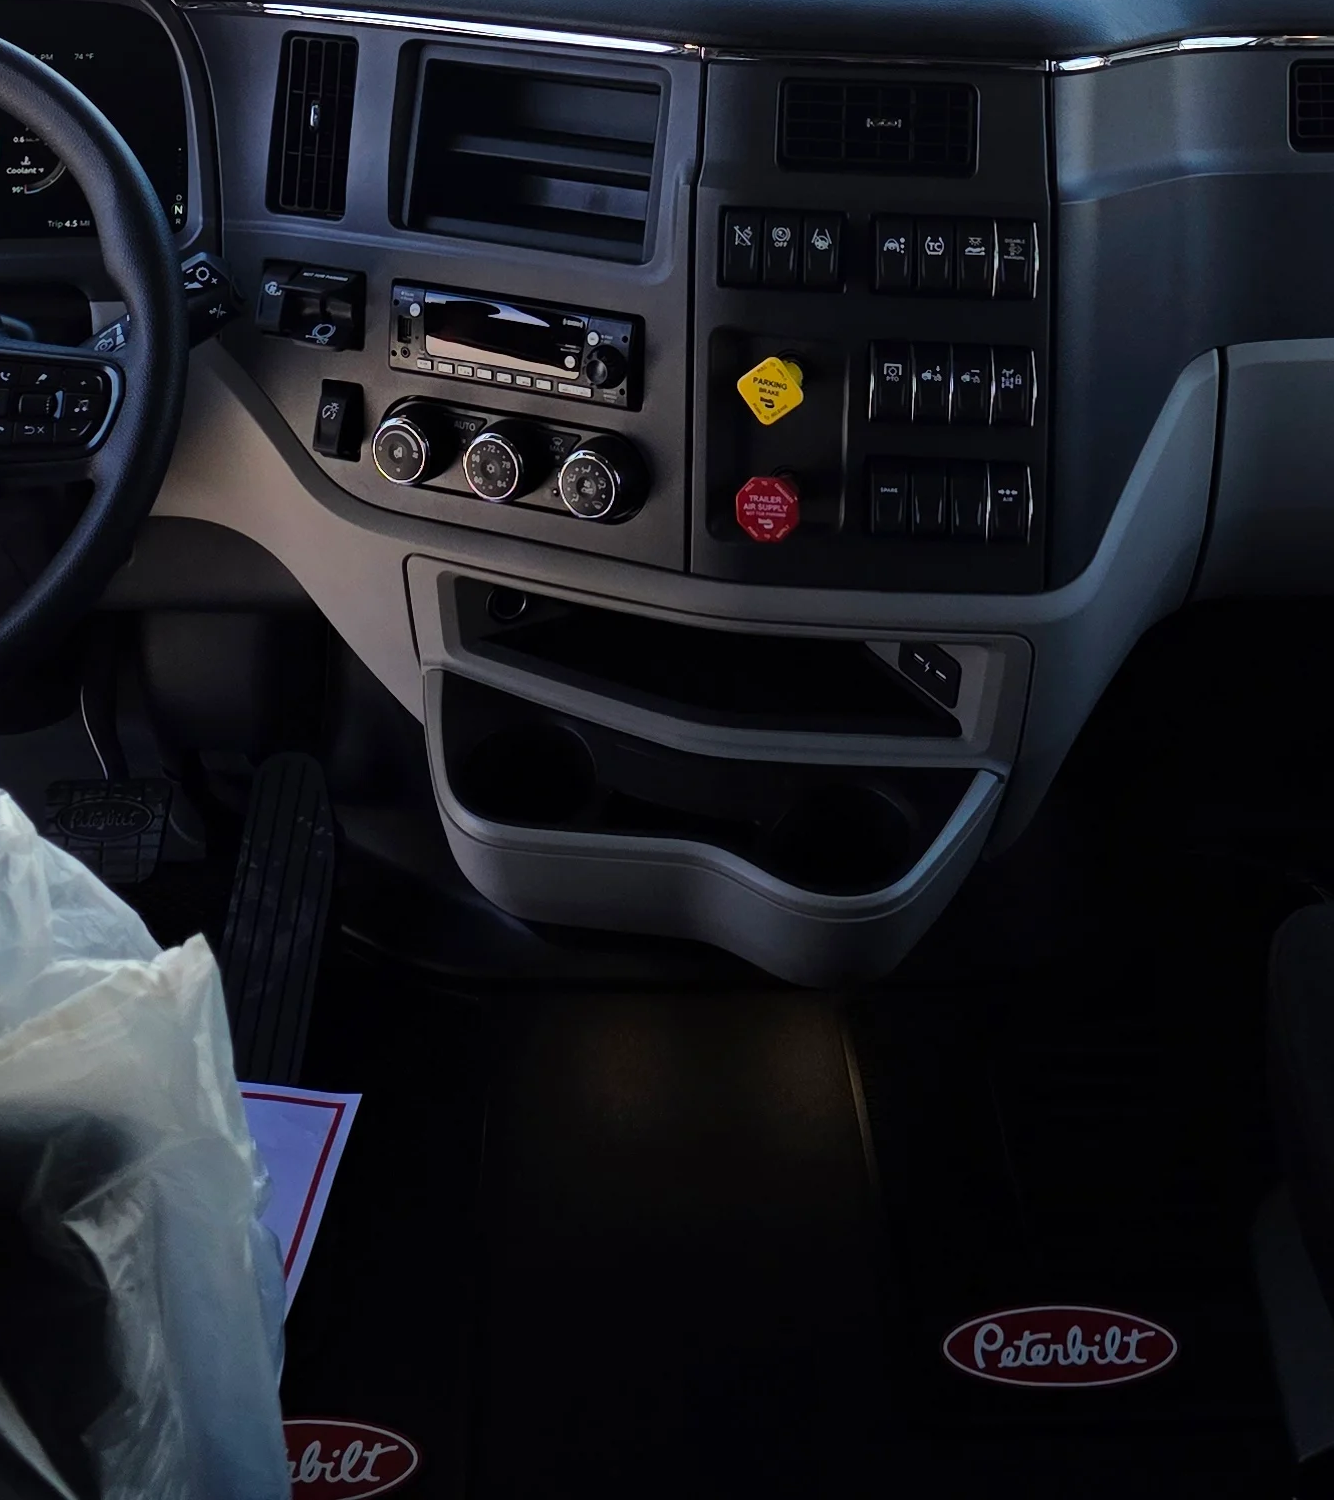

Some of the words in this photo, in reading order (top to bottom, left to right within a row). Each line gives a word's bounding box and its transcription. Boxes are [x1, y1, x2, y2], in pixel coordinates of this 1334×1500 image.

[6, 166, 37, 175] Coolant
[174, 205, 183, 215] N
[48, 220, 63, 229] Trip
[928, 242, 942, 251] TC
[752, 377, 788, 390] PARKING
[759, 387, 779, 397] BRAKE
[453, 421, 476, 432] AUTO
[486, 444, 497, 453] 72
[549, 444, 565, 453] MAX
[880, 486, 898, 494] SPARE
[748, 495, 782, 504] TRAILER
[757, 503, 788, 512] SUPPLY
[973, 1322, 1156, 1370] Peterbilt
